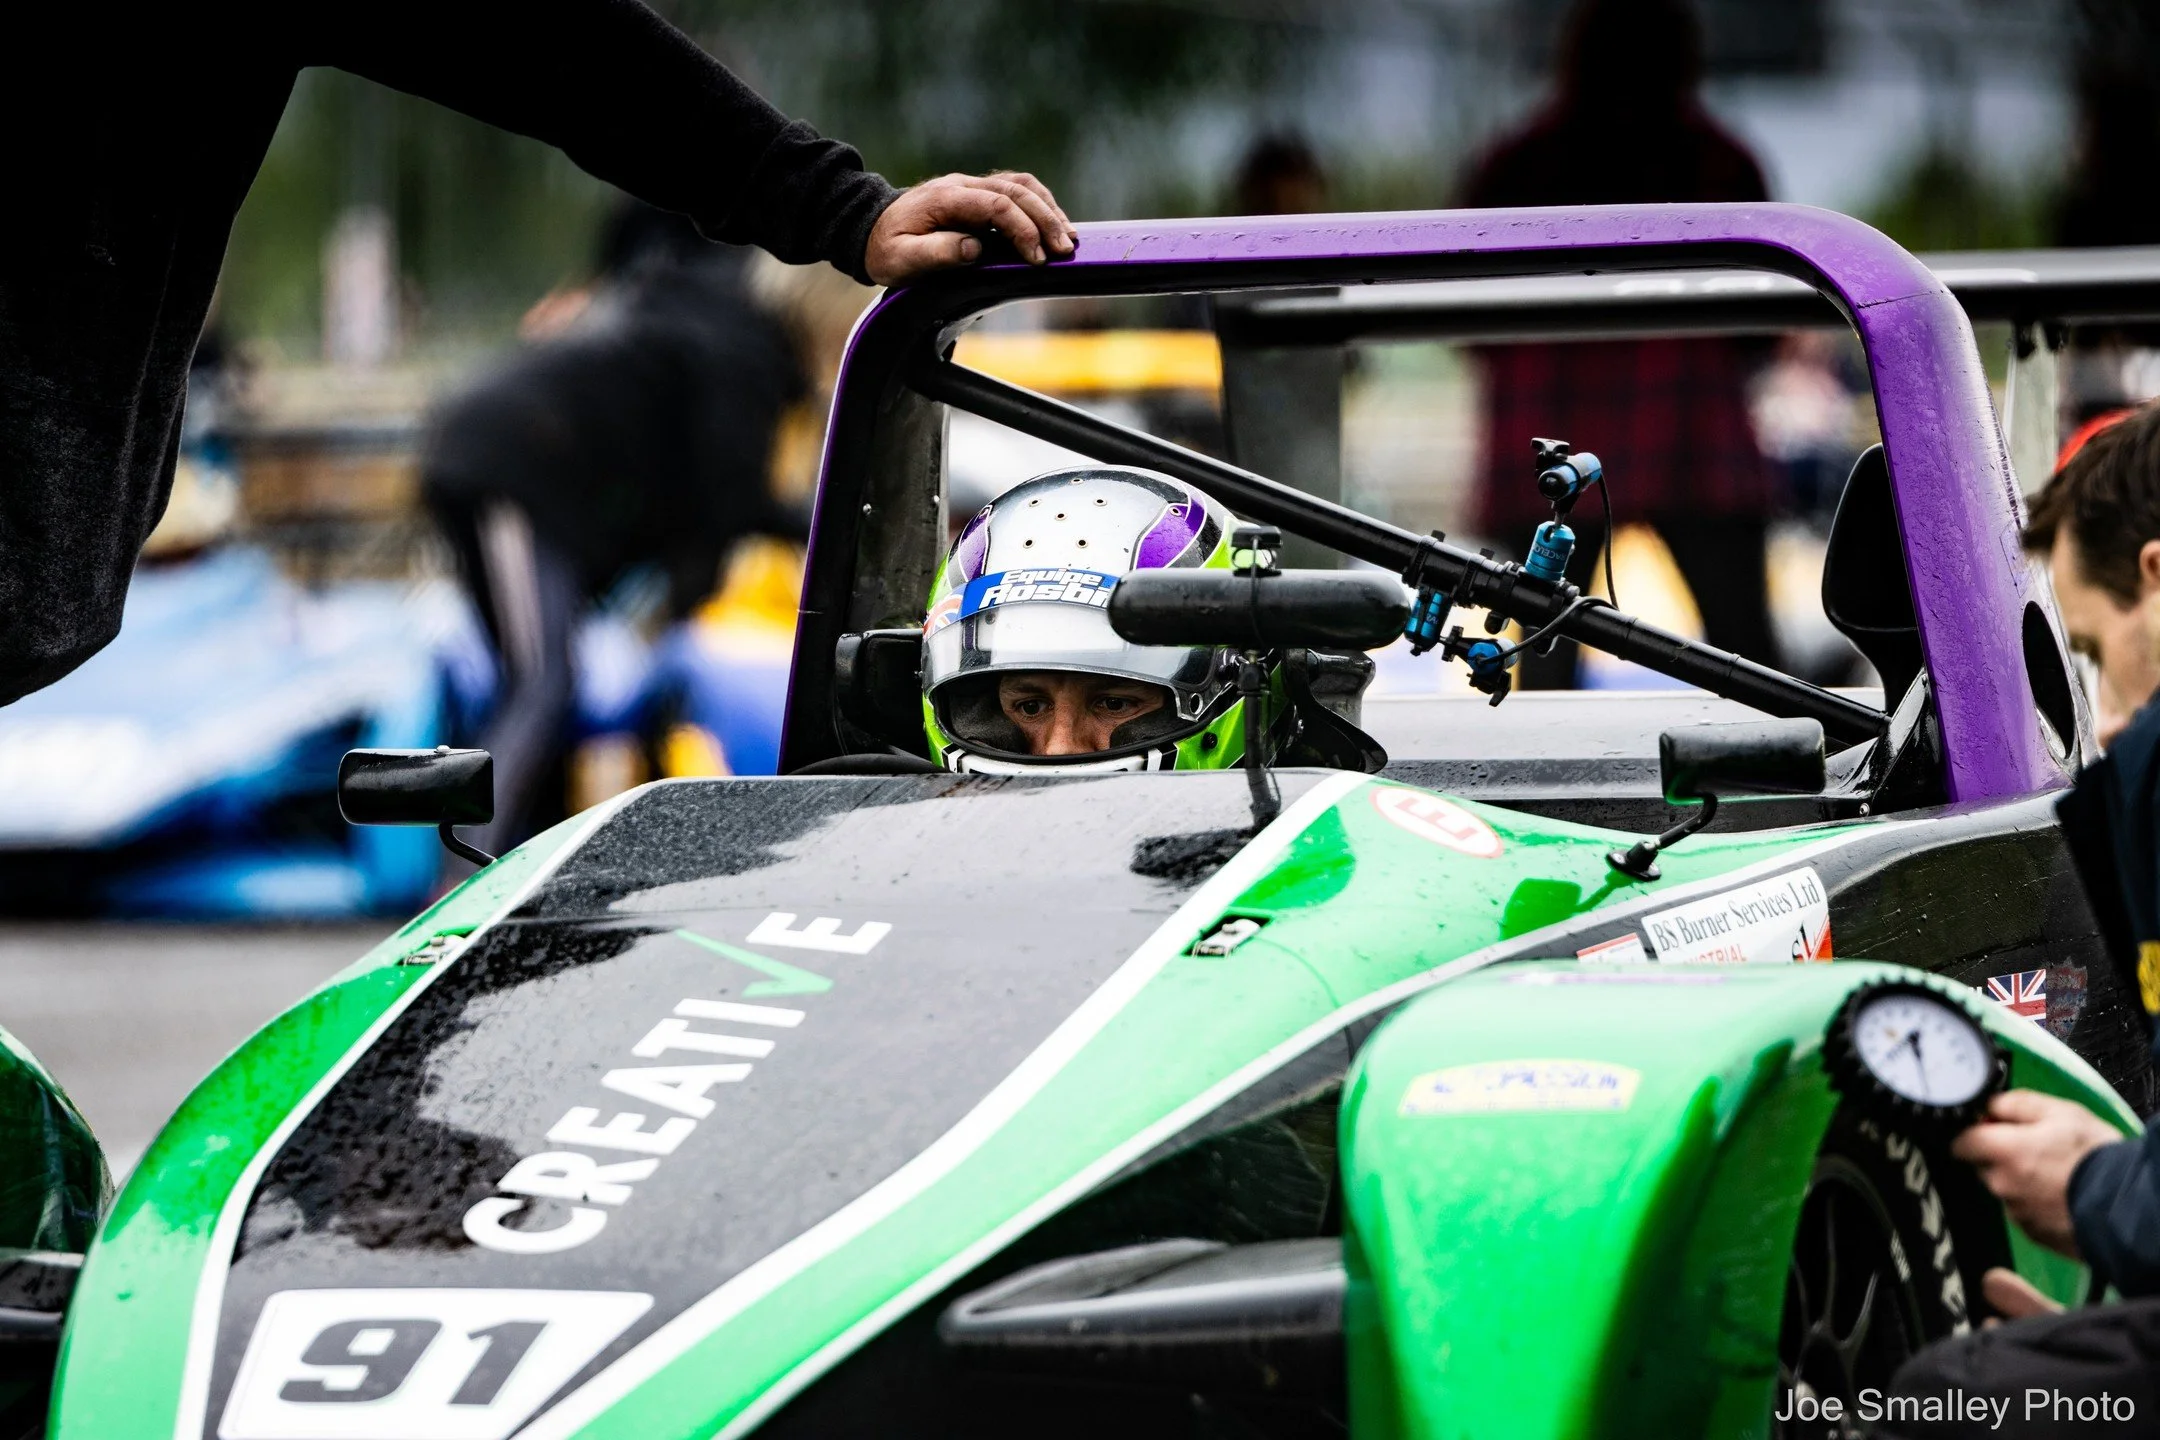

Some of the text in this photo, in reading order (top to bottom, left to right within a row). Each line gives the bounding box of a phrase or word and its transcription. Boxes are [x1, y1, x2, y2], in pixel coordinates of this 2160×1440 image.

[1000, 568, 1102, 586] Equipe
[1652, 876, 1821, 952] BS Burner Services Ltd
[463, 911, 892, 1254] CREATIVE
[278, 1319, 551, 1406] 91
